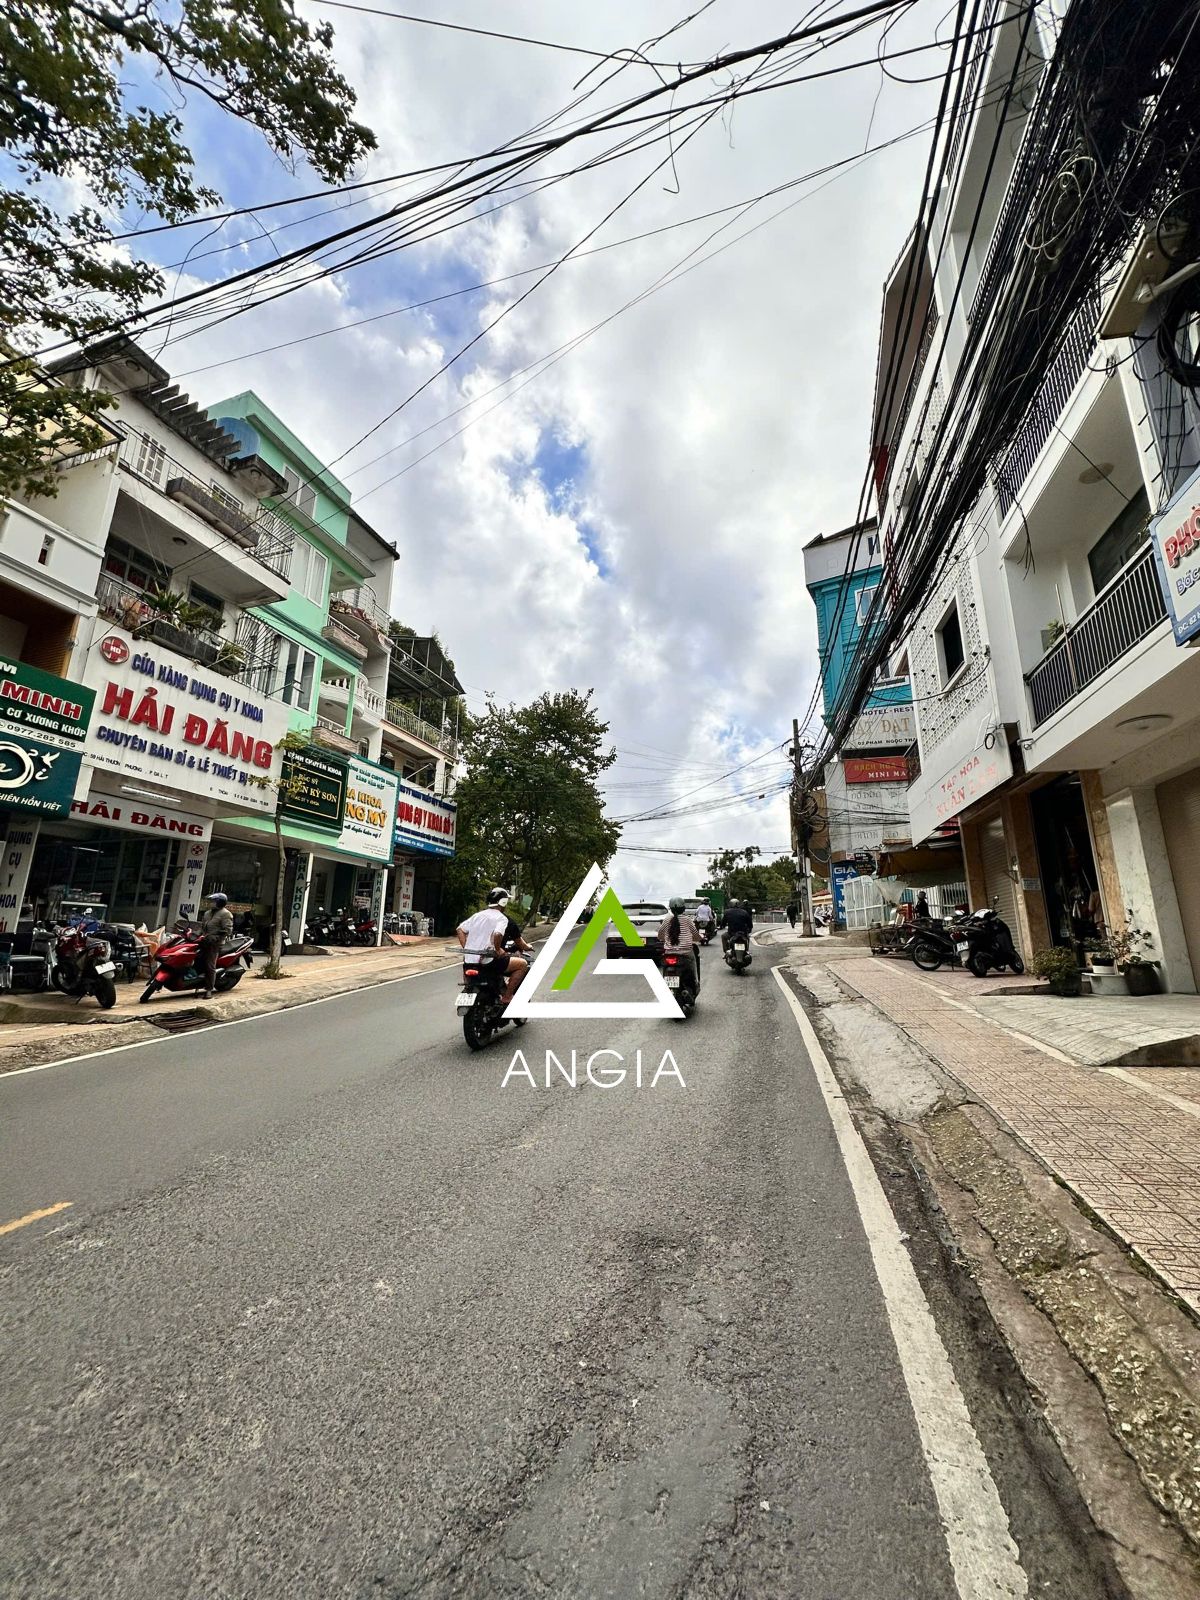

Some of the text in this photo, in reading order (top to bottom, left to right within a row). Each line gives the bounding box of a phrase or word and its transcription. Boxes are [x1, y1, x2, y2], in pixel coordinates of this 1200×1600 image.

[131, 652, 263, 723] CỬA HÀNG DỤNG CỤ Y KHOA
[0, 679, 83, 720] MINH
[25, 712, 60, 730] XƯƠNG
[101, 681, 273, 769] HẢI ĐĂNG
[58, 738, 76, 748] 585
[96, 725, 148, 753] CHUYÊN
[148, 742, 174, 761] BÁN
[186, 755, 196, 768] &
[211, 764, 238, 781] THIẾT
[70, 801, 203, 837] HẢI ĐĂNG
[8, 831, 33, 847] DỤNG
[8, 852, 22, 869] CỤ
[7, 873, 14, 887] Y
[0, 894, 17, 909] HOA
